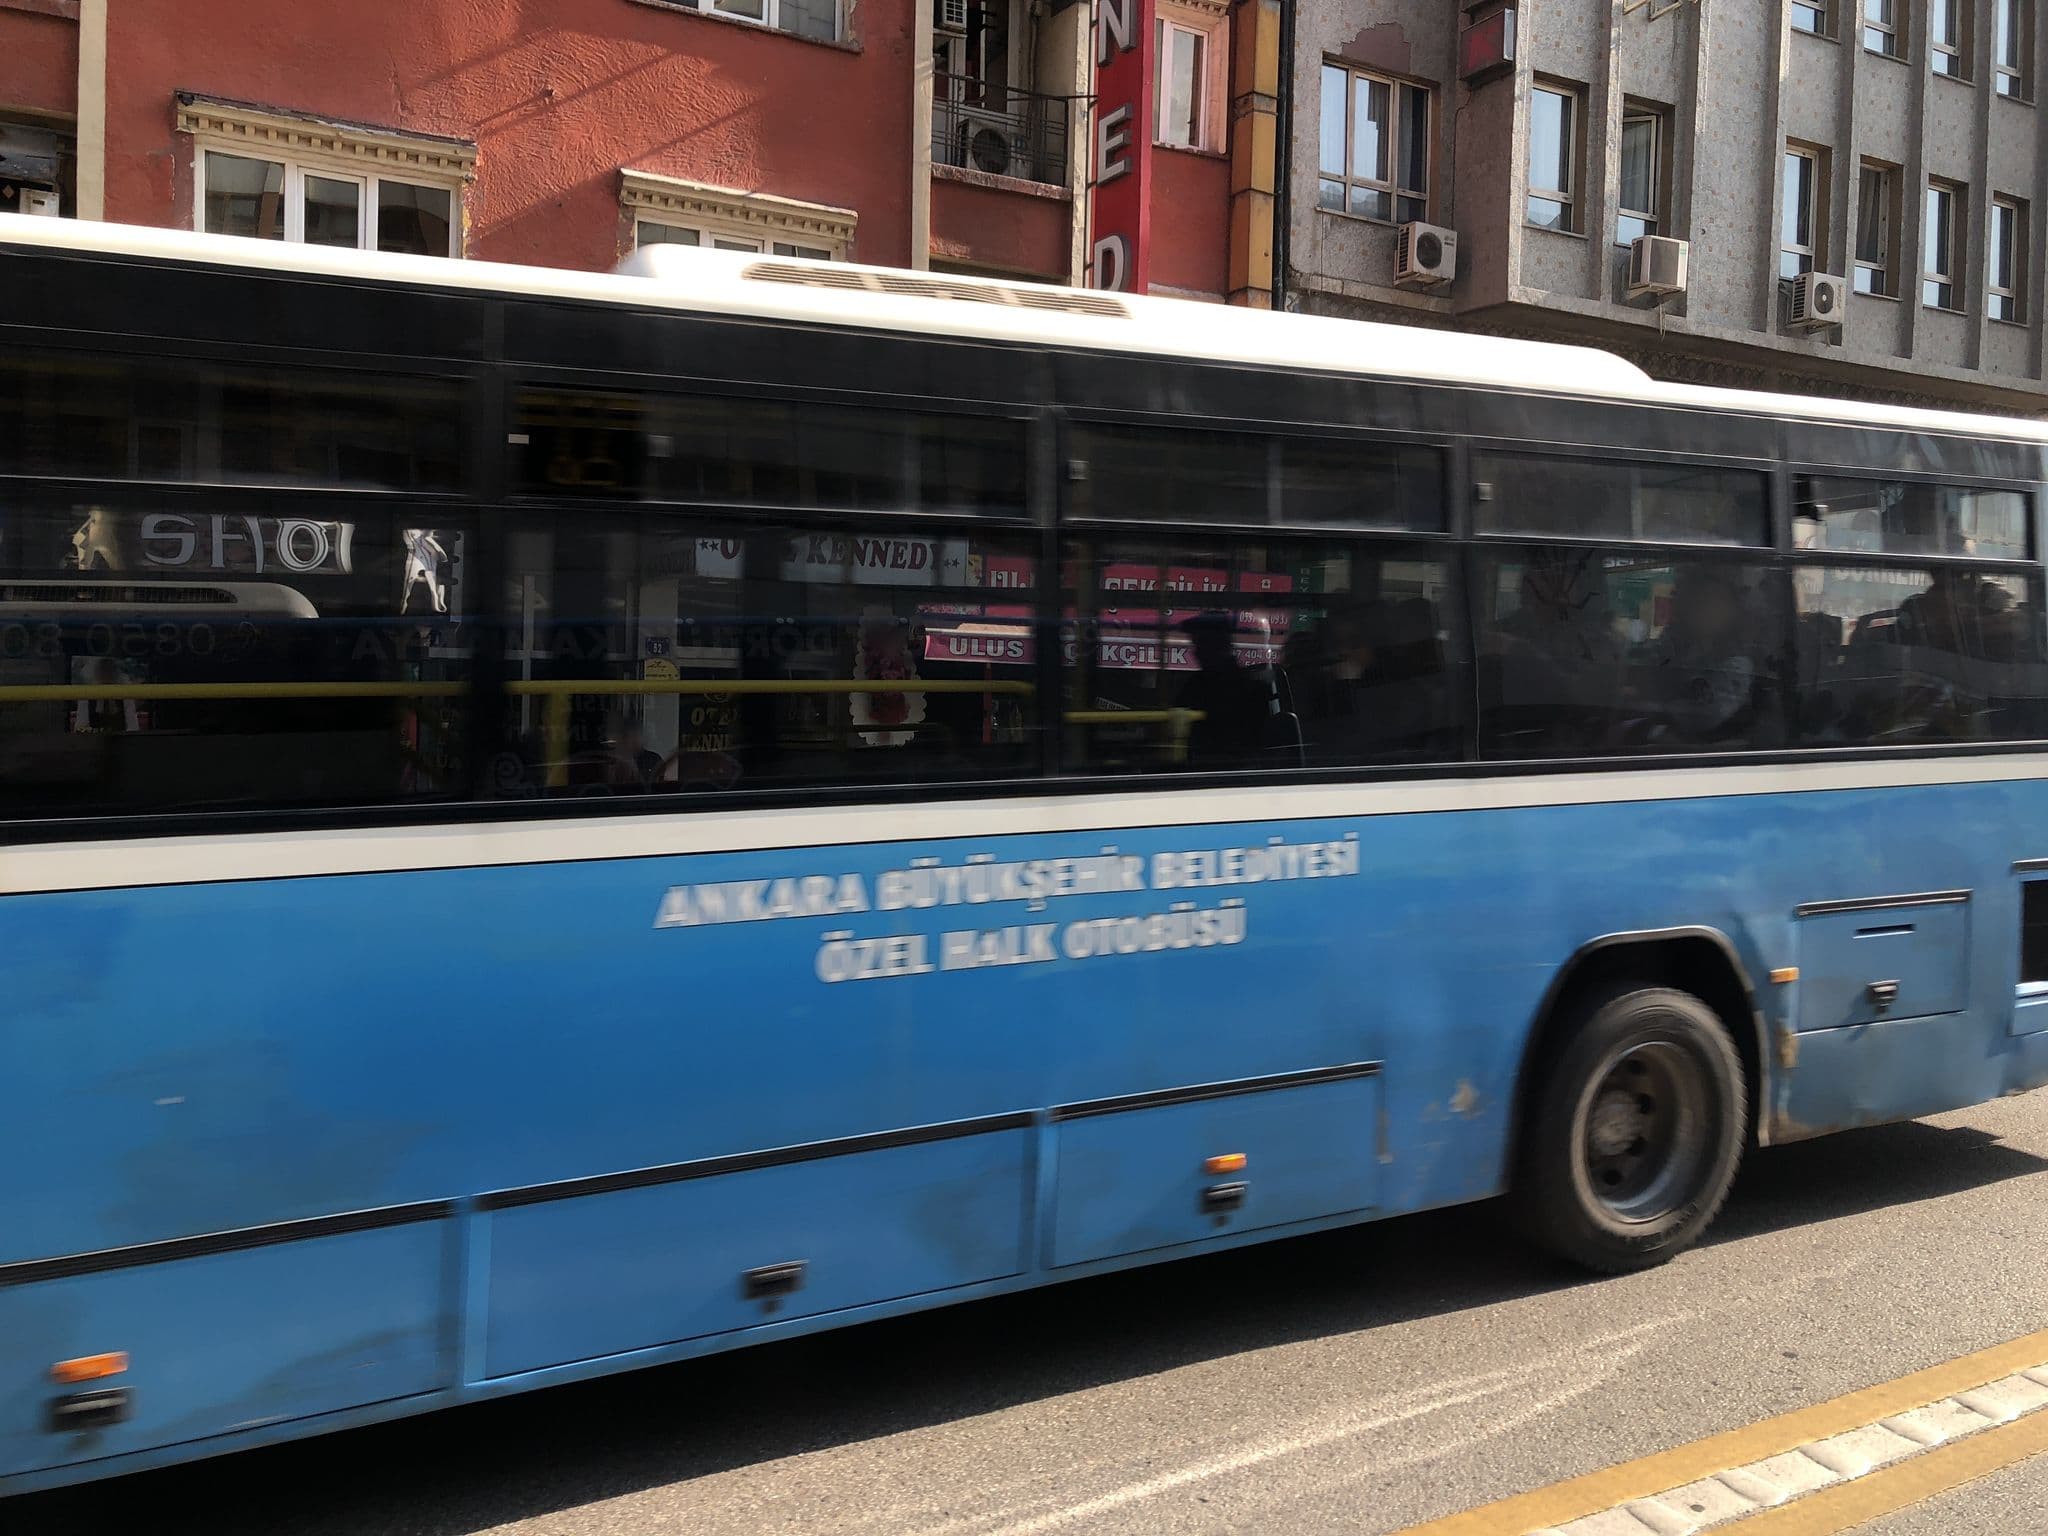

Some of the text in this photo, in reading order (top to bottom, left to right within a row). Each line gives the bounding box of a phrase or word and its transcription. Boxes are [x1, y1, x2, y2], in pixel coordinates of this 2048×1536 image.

[948, 636, 1188, 667] ULUS ÇKÇİLİK
[653, 832, 1361, 929] ANKARA BÜYÜKŞEHİR BELEDİYESİ
[815, 898, 1248, 983] ÖZEL HALK OTOBÜSÜ
